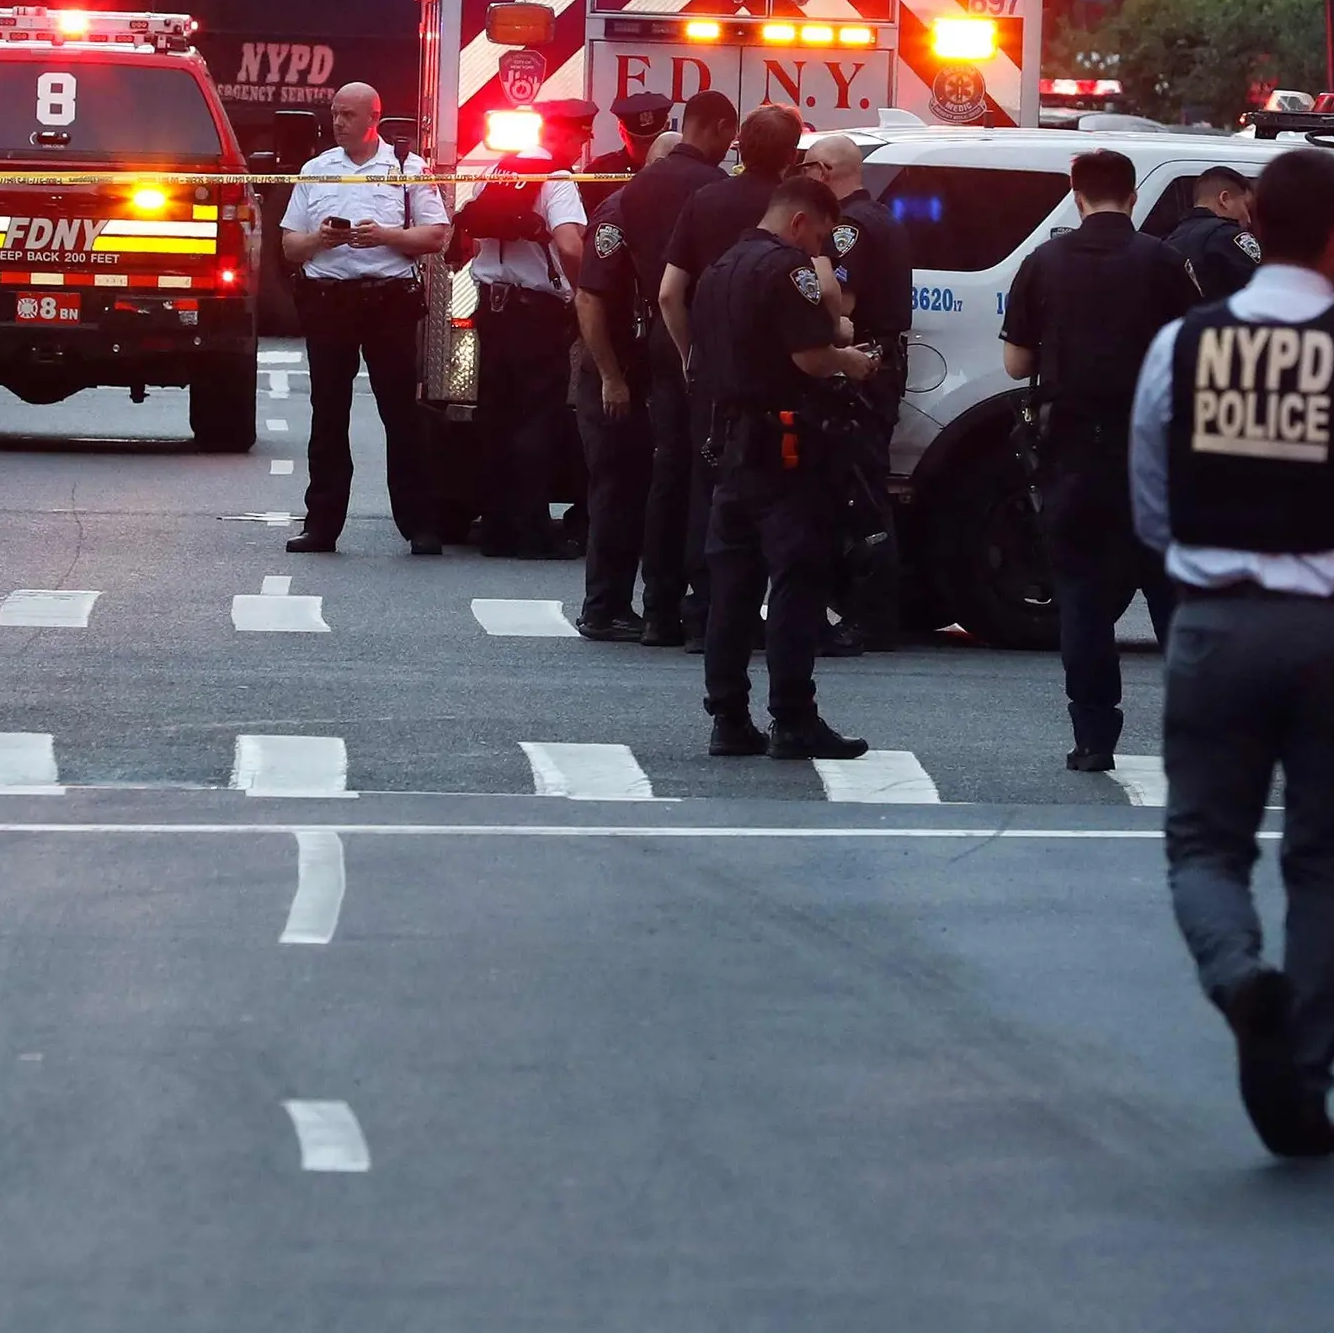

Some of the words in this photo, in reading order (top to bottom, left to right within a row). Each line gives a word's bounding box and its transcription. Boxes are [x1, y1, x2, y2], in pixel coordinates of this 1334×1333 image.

[237, 42, 334, 85] NYPD
[36, 72, 77, 126] 8
[945, 101, 973, 115] MEDIC
[2, 216, 110, 252] FDNY
[27, 250, 60, 263] BACK
[64, 252, 86, 264] 200
[91, 253, 120, 264] FEET
[39, 297, 57, 320] 8
[60, 308, 79, 321] BN
[1196, 326, 1334, 393] NYPD
[1194, 389, 1331, 443] POLICE
